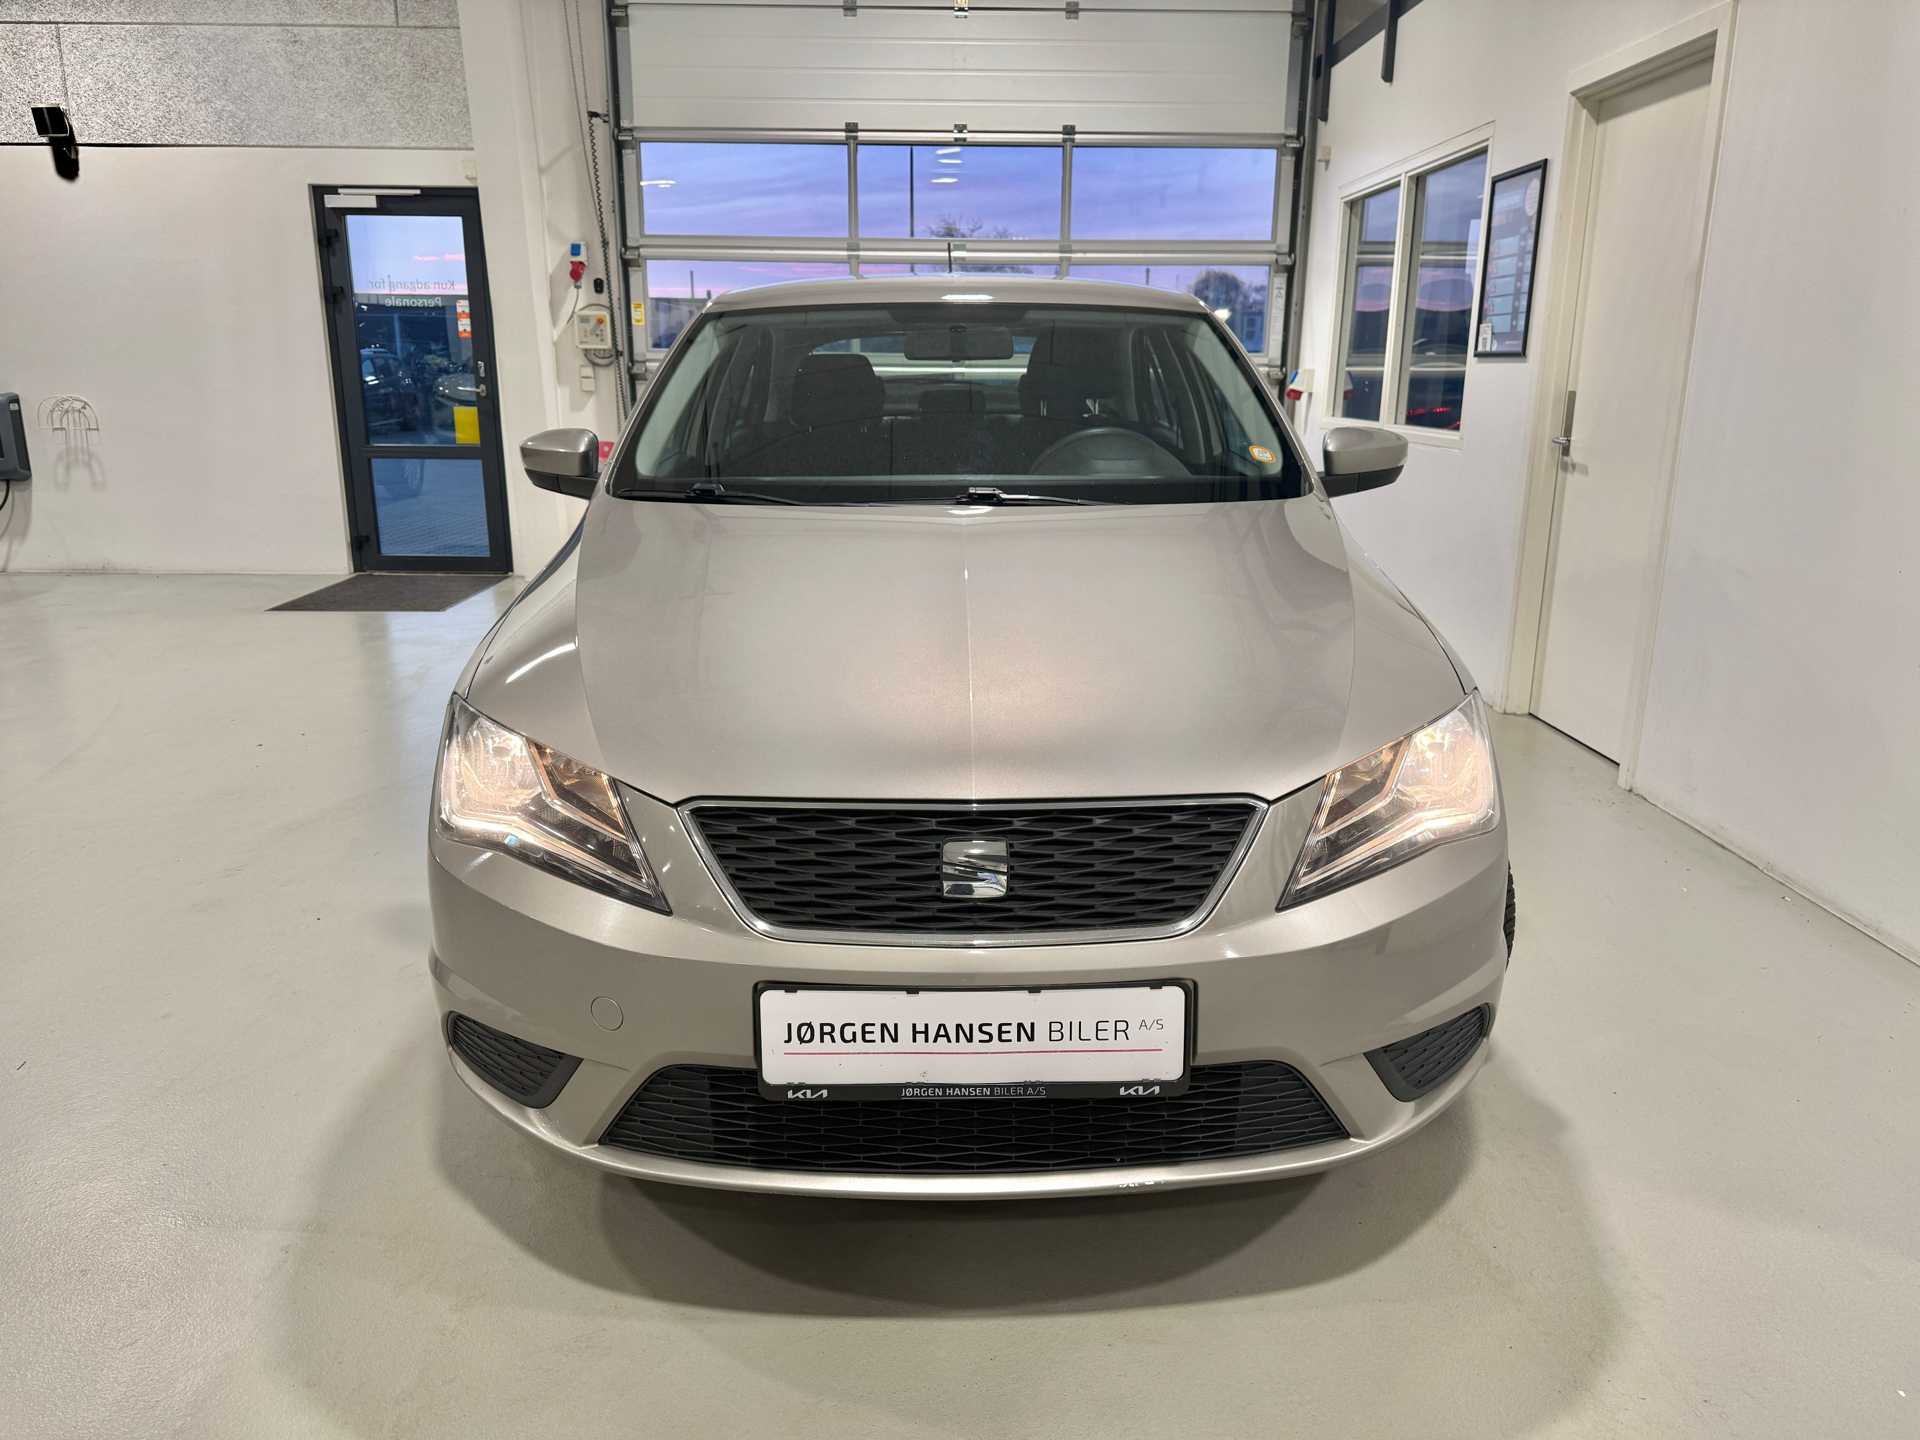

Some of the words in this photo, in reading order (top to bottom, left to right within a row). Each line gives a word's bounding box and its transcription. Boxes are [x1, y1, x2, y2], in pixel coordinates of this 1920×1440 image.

[784, 1021, 899, 1045] JØRGEN
[911, 1021, 1035, 1043] HANSEN
[1048, 1019, 1130, 1042] BILER
[1138, 1018, 1165, 1031] A/S
[901, 1087, 943, 1097] JØRGEN
[946, 1087, 991, 1096] HANSEN
[994, 1086, 1024, 1096] BILER
[1026, 1086, 1046, 1095] A/S
